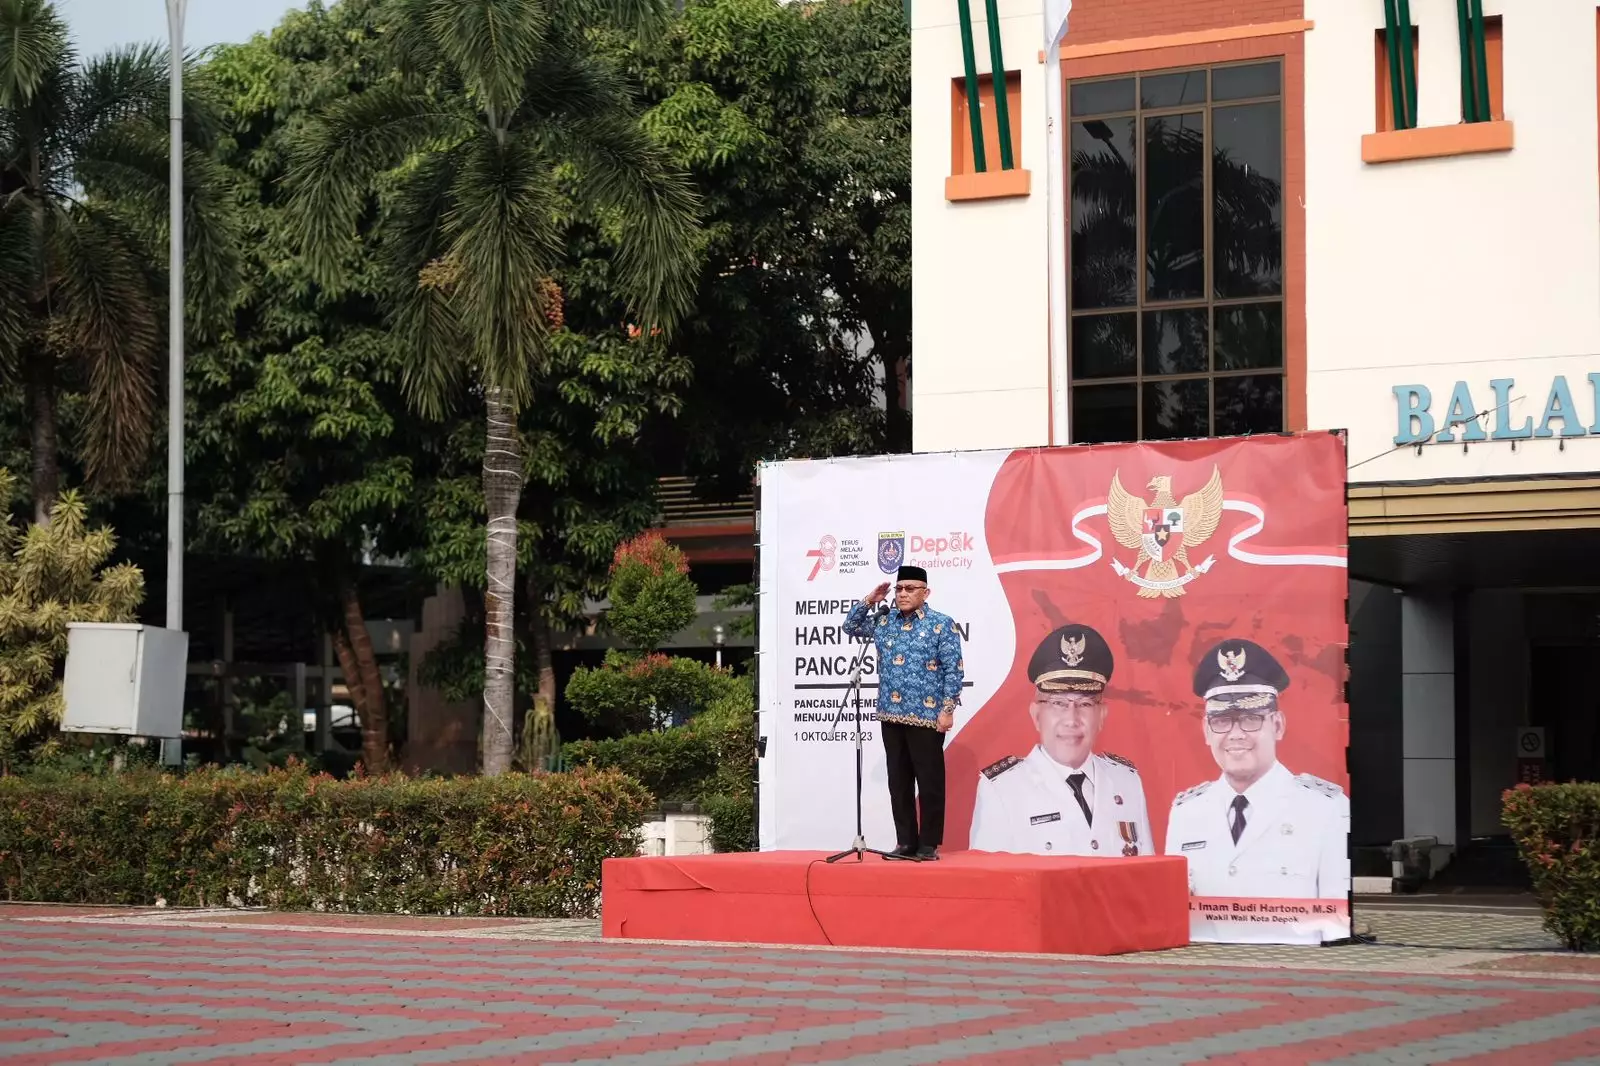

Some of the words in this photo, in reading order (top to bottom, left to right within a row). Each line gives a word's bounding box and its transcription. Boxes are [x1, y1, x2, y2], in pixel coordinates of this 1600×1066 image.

[795, 626, 842, 645] HARI
[794, 699, 848, 709] PANCASILA
[794, 712, 835, 722] MENUJU
[794, 731, 799, 741] 1
[849, 731, 873, 741] 223
[1199, 902, 1229, 911] Imam
[1232, 902, 1257, 912] Budi
[1259, 903, 1309, 914] Hartono,
[1312, 904, 1337, 914] M.Si
[1272, 915, 1299, 924] Depok
